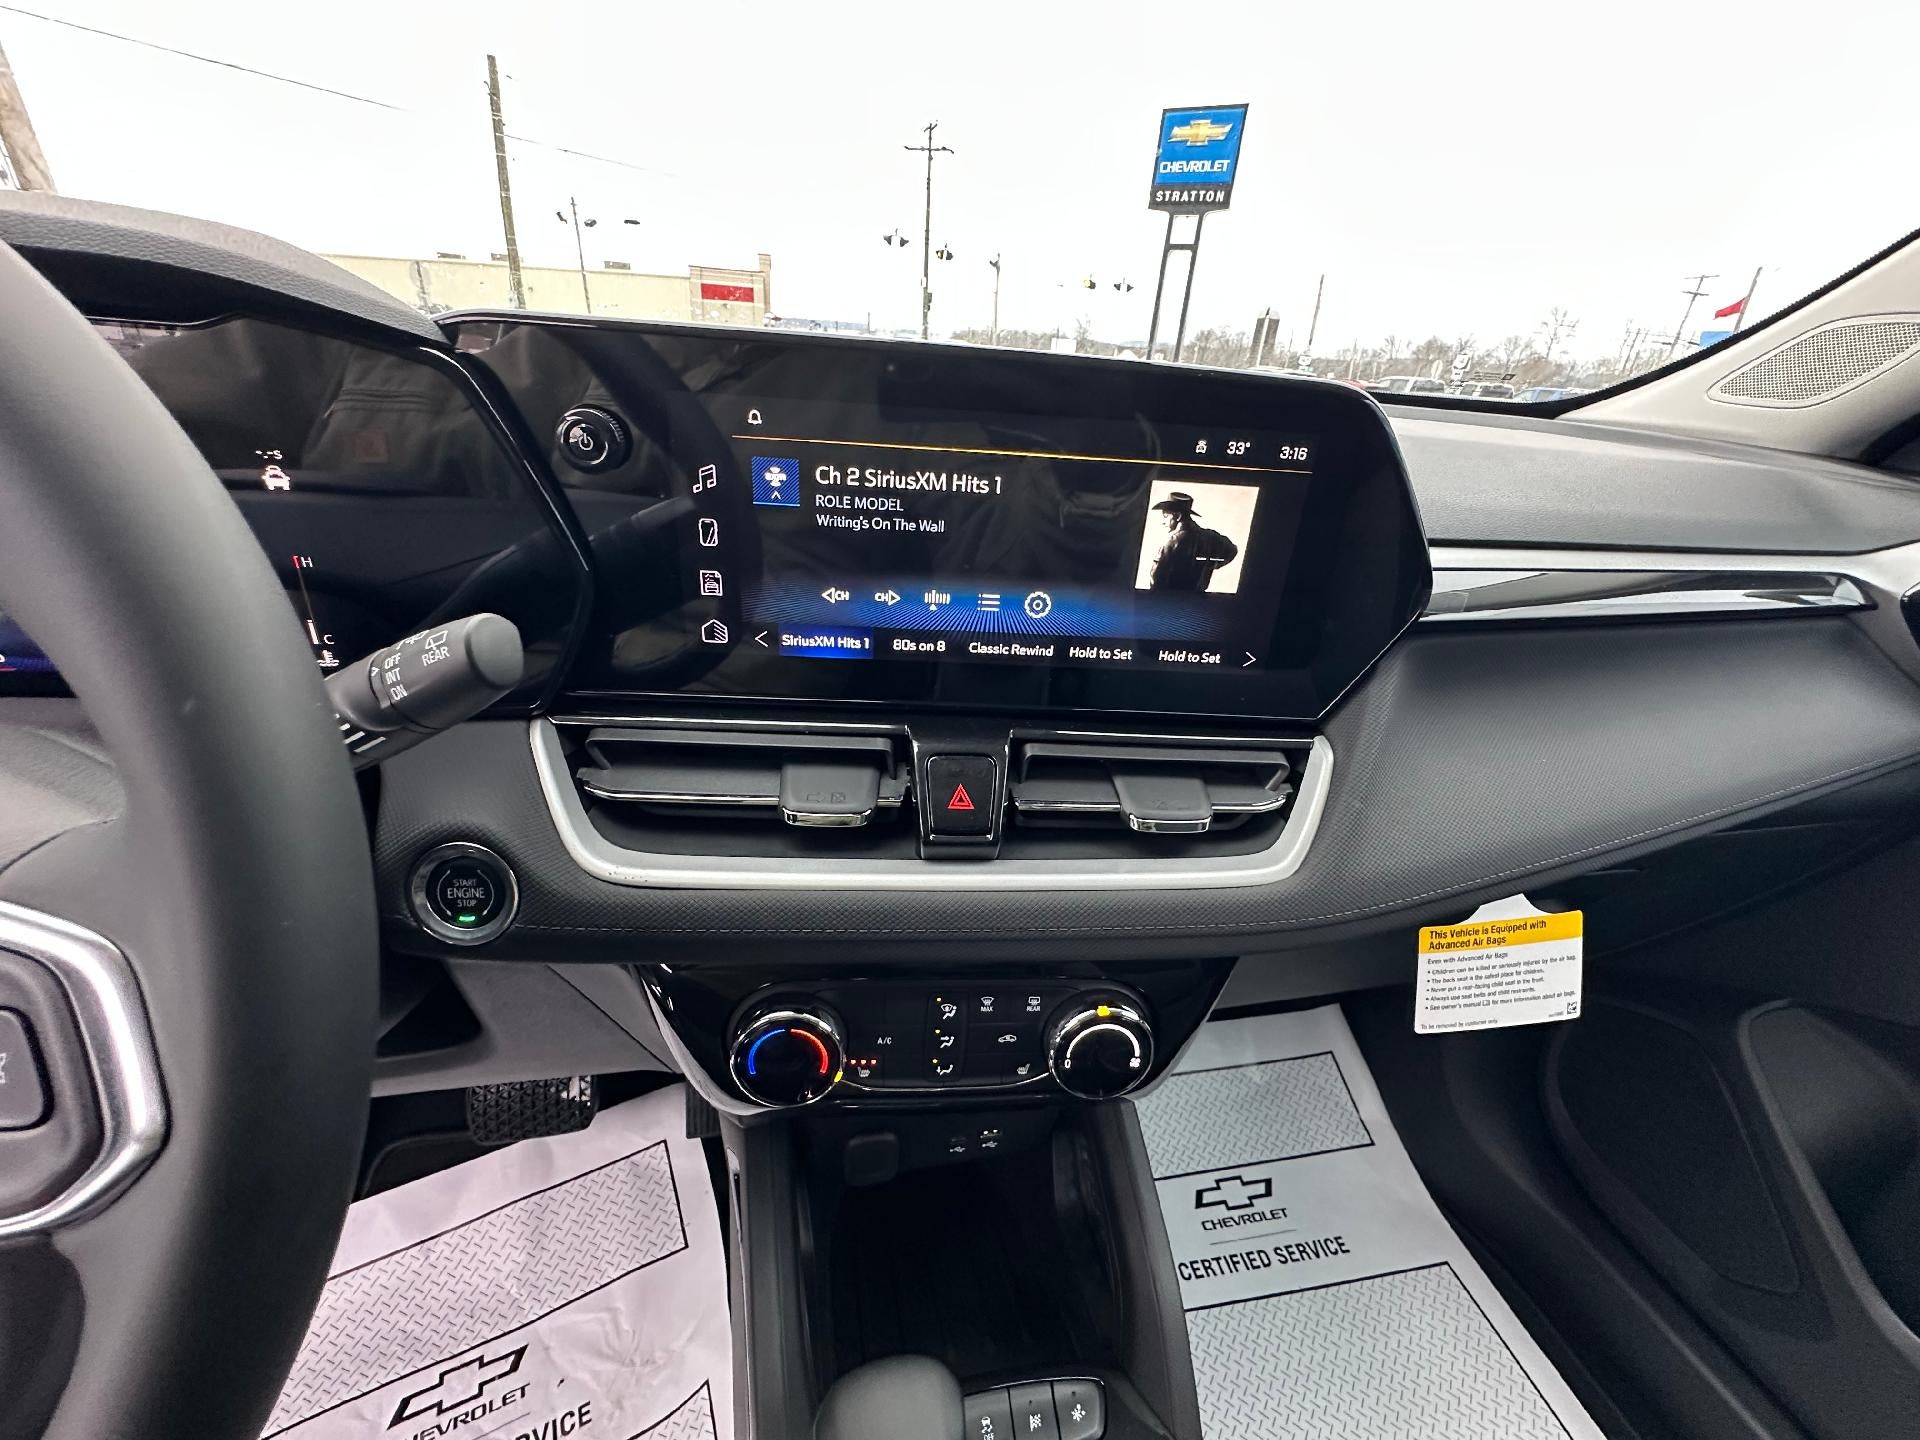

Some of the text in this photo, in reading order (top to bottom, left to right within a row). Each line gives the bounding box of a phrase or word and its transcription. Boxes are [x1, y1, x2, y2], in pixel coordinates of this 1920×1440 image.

[1160, 160, 1230, 173] CHEVROLET
[1155, 190, 1225, 202] STRATTON
[1227, 441, 1250, 455] 33°
[1280, 446, 1308, 460] 3:16
[815, 465, 1001, 494] Ch 2 SiriusXM Hits 1
[815, 494, 904, 511] ROLE MODEL
[816, 514, 944, 533] Writing's On The Wall
[301, 556, 313, 568] H
[835, 590, 849, 601] CH
[875, 592, 888, 602] CH
[324, 635, 335, 644] C
[782, 634, 870, 649] SiriusXM Hits 1
[893, 639, 946, 652] 80s on 8
[421, 647, 450, 666] REAR
[969, 642, 1054, 657] Classic Rewind
[1069, 646, 1132, 660] Hold to Set
[384, 652, 402, 670] OFF
[1158, 650, 1220, 664] Hold to Set
[385, 668, 401, 684] INT
[390, 684, 408, 700] ON
[454, 879, 477, 887] START
[447, 887, 485, 899] ENGINE
[1430, 920, 1546, 939] This Vehicle is Equipped with
[1429, 936, 1507, 950] Advanced Air Bags
[1457, 954, 1484, 962] Advanced
[877, 1037, 892, 1045] A/C
[1201, 1207, 1288, 1231] CHEVROLET
[1178, 1236, 1350, 1281] CERTIFIED SERVICE
